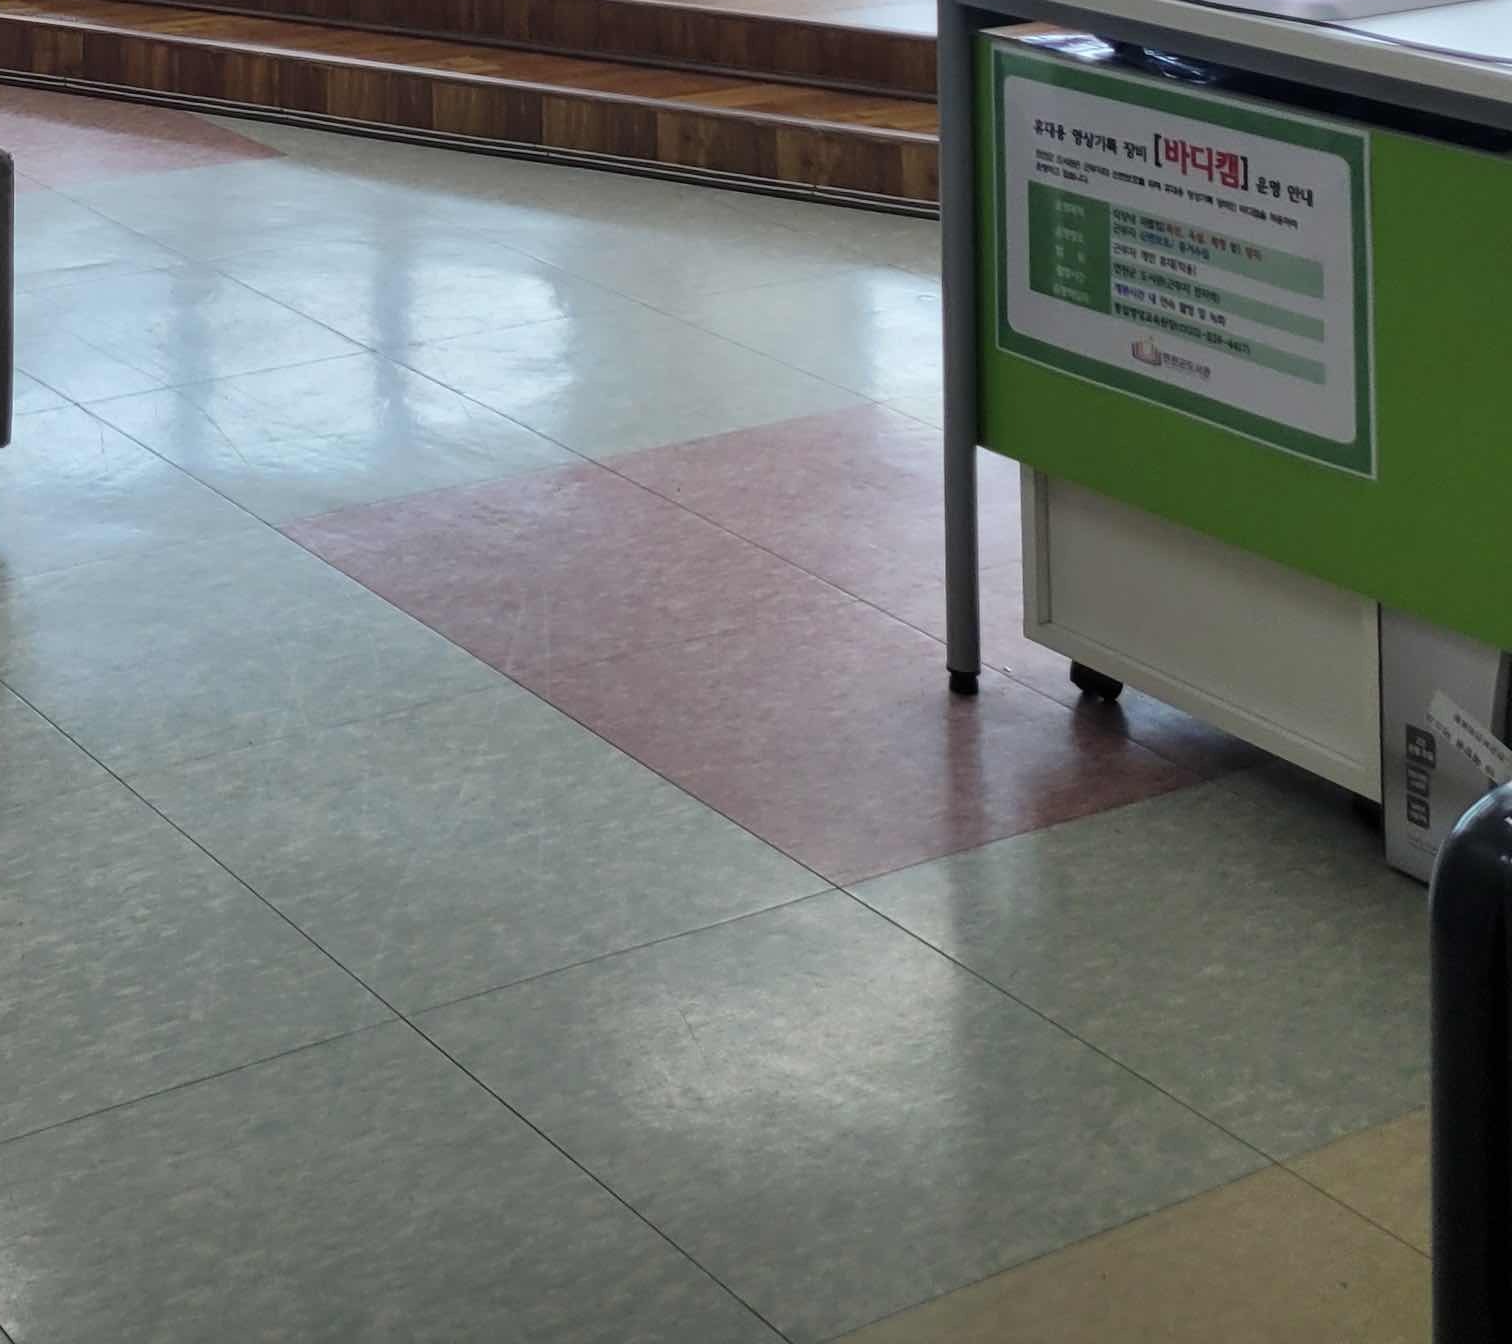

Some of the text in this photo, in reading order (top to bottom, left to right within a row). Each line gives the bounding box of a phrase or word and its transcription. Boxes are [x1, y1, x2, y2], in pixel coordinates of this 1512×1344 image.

[1033, 118, 1313, 208] 휴대용 영상기록 장비 [바디캠] 운영 안내
